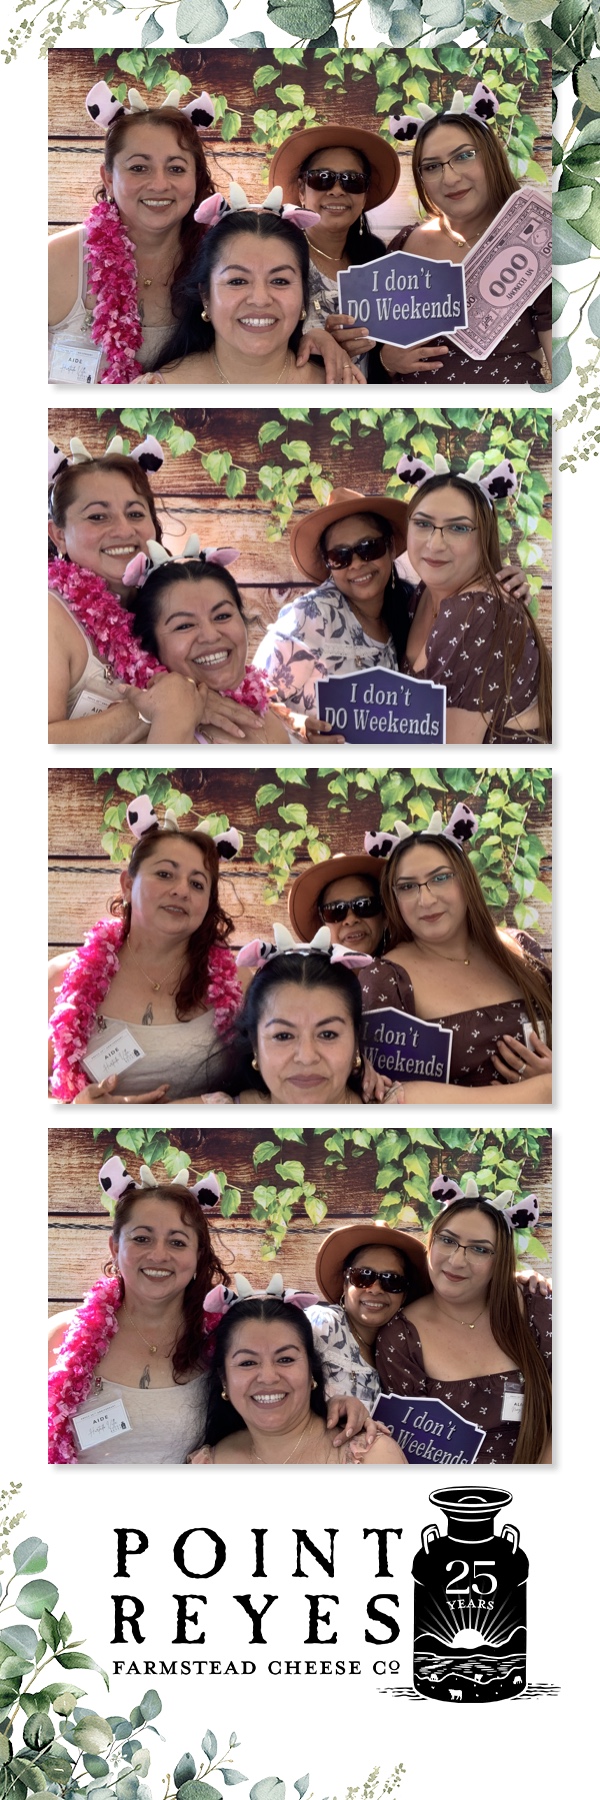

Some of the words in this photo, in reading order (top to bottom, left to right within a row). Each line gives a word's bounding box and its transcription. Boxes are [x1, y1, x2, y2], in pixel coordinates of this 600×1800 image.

[372, 271, 379, 292] I
[385, 267, 432, 291] don't
[347, 298, 371, 322] DO
[376, 294, 461, 321] Weekends
[350, 683, 358, 703] I
[363, 683, 411, 706] don't
[325, 707, 347, 729] DO
[353, 709, 440, 736] Weekends
[361, 1022, 370, 1041] I
[373, 1023, 419, 1048] don't
[104, 1047, 119, 1060] AIDE
[364, 1046, 444, 1077] Weekends
[93, 1415, 108, 1424] AIDE
[401, 1406, 414, 1424] I
[413, 1411, 456, 1441] don't
